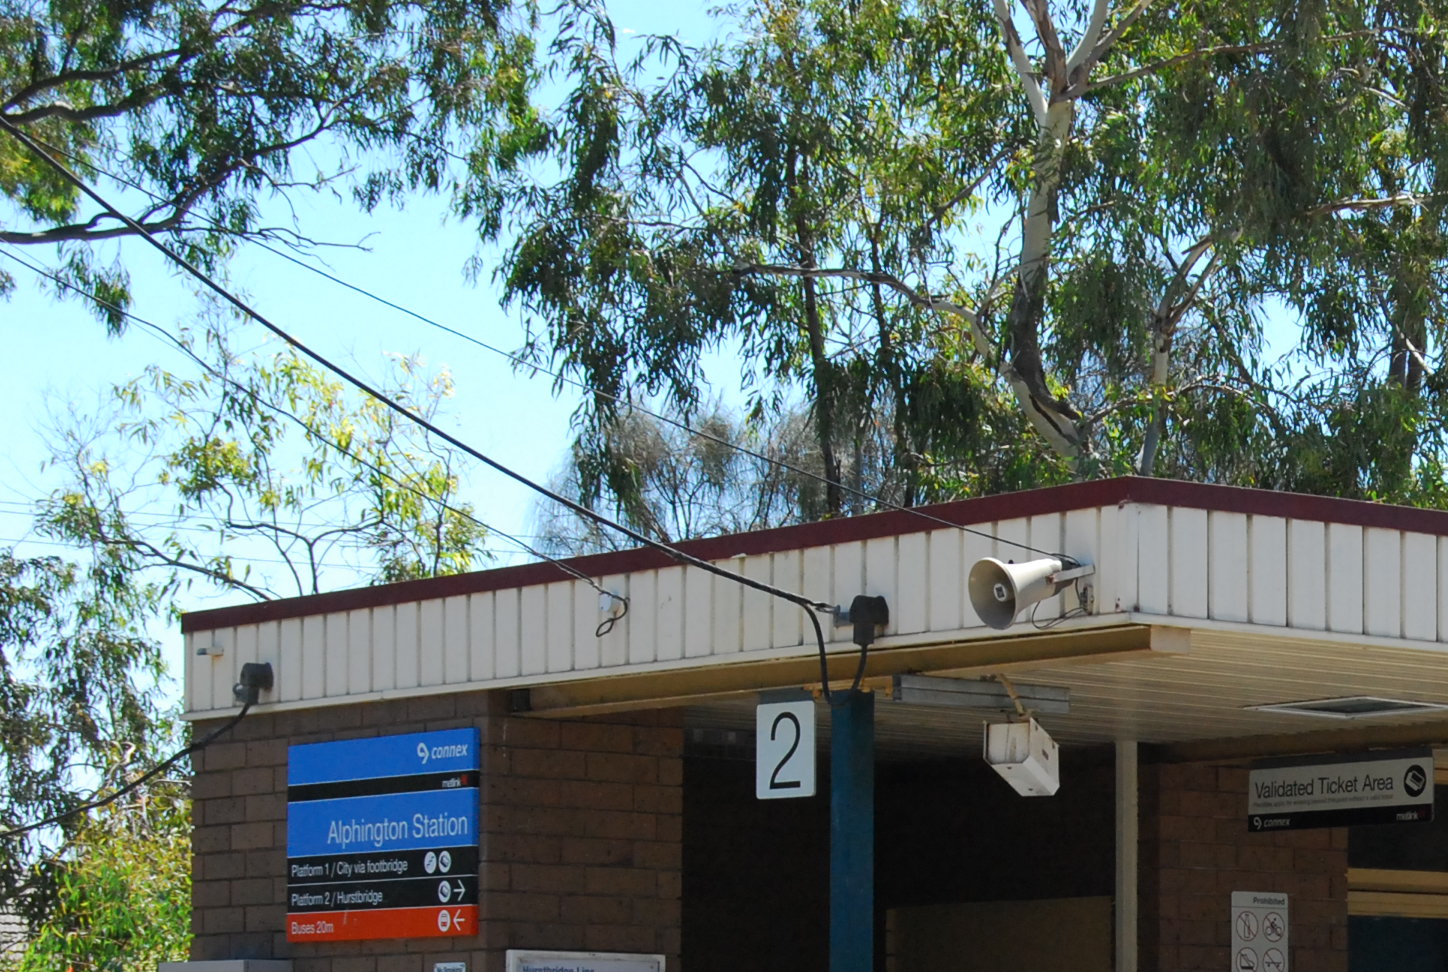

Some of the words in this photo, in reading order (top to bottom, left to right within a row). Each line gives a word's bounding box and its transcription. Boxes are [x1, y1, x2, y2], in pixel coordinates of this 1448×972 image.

[431, 743, 468, 759] connex
[769, 711, 800, 790] 2
[1255, 779, 1314, 799] Validated
[1318, 776, 1357, 794] Ticket
[1362, 774, 1393, 791] Area
[327, 818, 408, 848] Alphington
[413, 812, 468, 838] Station
[1264, 817, 1291, 828] connex
[291, 864, 323, 878] Platform
[325, 863, 329, 875] 1
[331, 862, 336, 878] /
[337, 862, 353, 876] City
[354, 861, 366, 873] via
[367, 860, 408, 875] footbridge
[291, 893, 323, 906] Platform
[325, 893, 330, 904] 2
[331, 892, 336, 907] /
[337, 890, 383, 905] Hurstbridge
[1253, 896, 1285, 906] Prohibited
[291, 921, 314, 935] Buses
[316, 921, 334, 933] 20m
